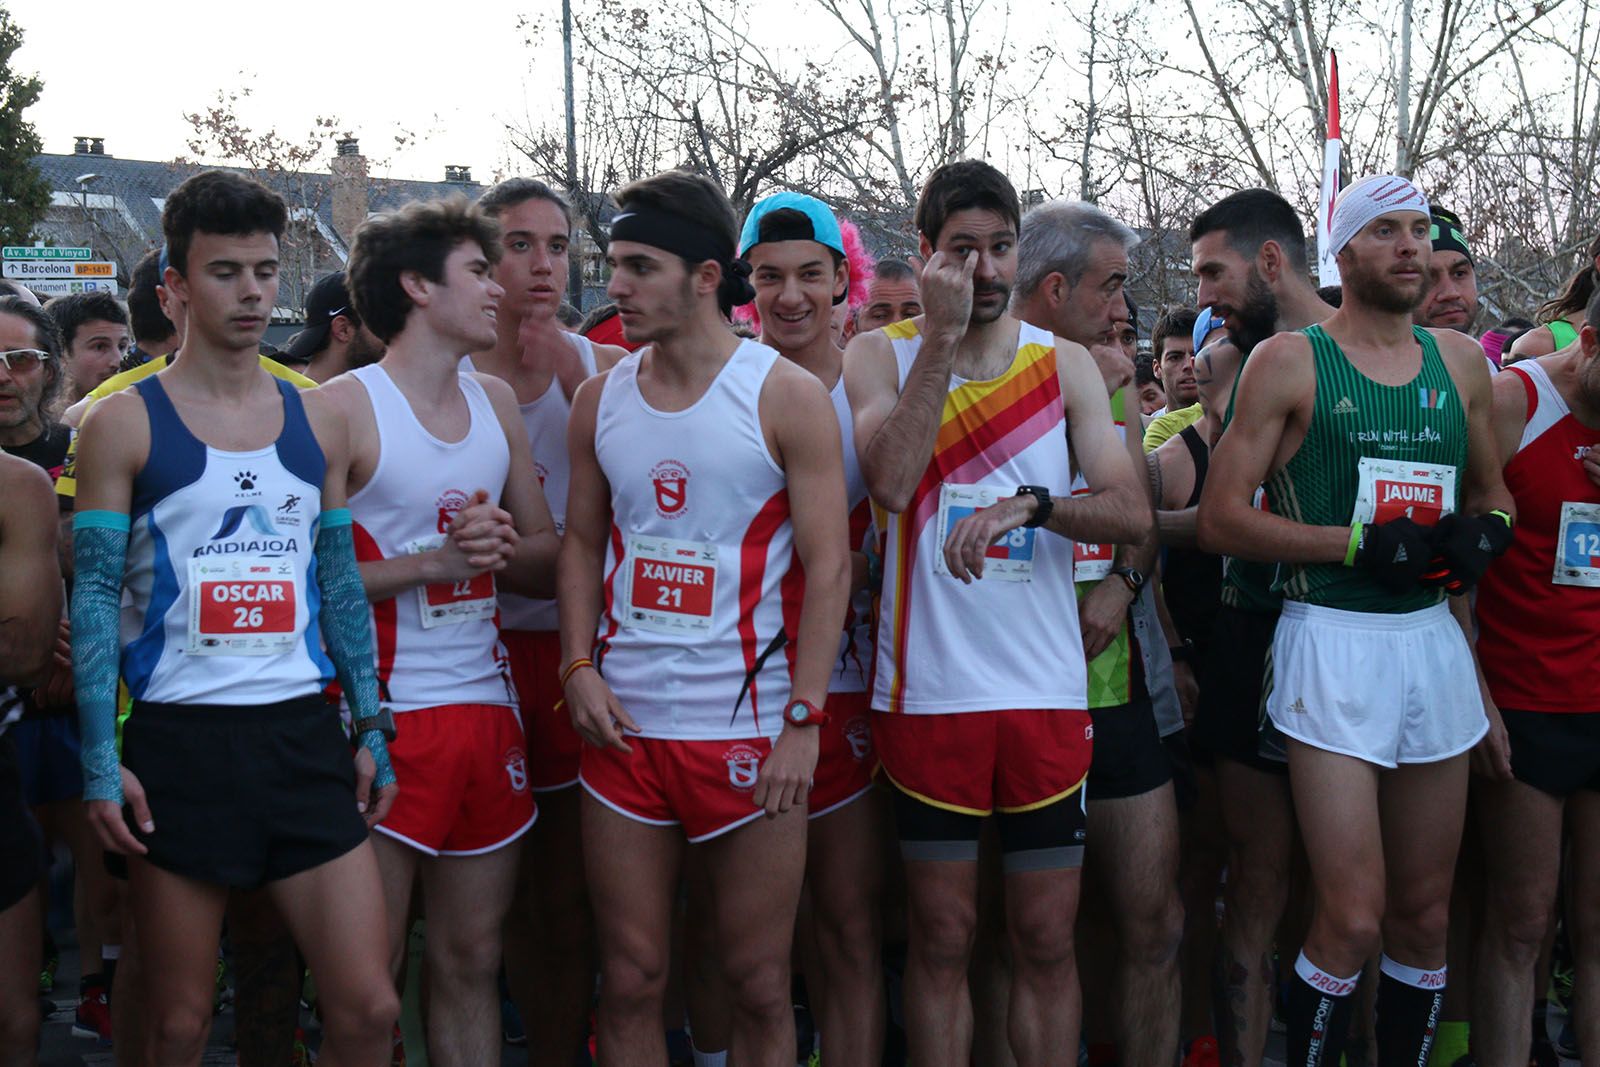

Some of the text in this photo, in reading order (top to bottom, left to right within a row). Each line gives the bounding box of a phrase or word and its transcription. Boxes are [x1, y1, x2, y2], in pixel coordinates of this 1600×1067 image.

[7, 248, 87, 257] Av. Pla del Vinyet
[21, 263, 110, 273] Barcelona BP-1417
[1349, 431, 1354, 443] I
[1357, 430, 1379, 442] RUN
[1383, 430, 1408, 443] WITH
[1383, 484, 1436, 503] JAUME
[1404, 506, 1414, 518] 1
[1078, 543, 1100, 556] 14
[642, 562, 705, 586] XAVIER
[213, 584, 285, 602] OSCAR
[453, 580, 472, 597] 22
[656, 586, 682, 608] 21
[233, 607, 264, 628] 26
